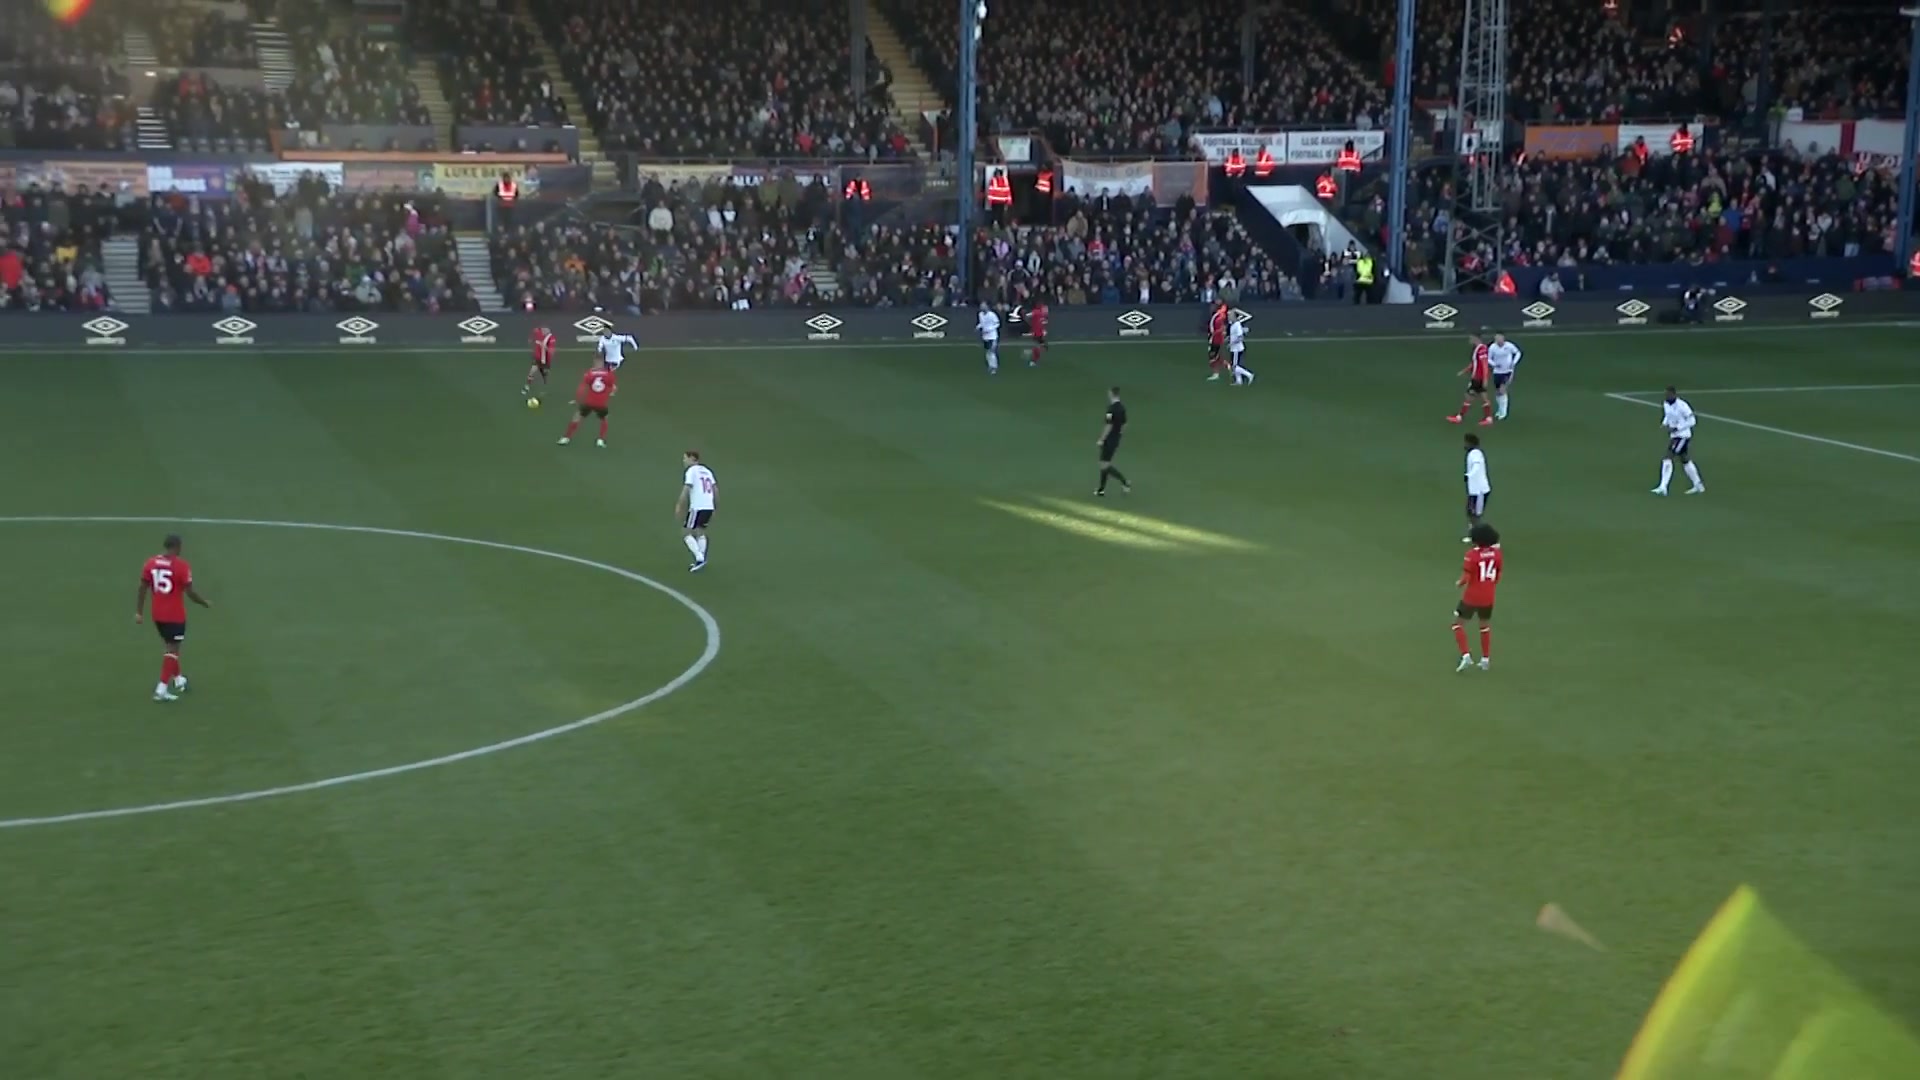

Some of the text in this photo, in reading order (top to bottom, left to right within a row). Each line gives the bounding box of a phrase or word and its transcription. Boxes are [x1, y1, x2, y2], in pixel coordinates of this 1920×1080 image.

[591, 376, 606, 393] 6
[699, 476, 712, 494] 10
[150, 568, 173, 594] 15
[1478, 560, 1497, 582] 14
